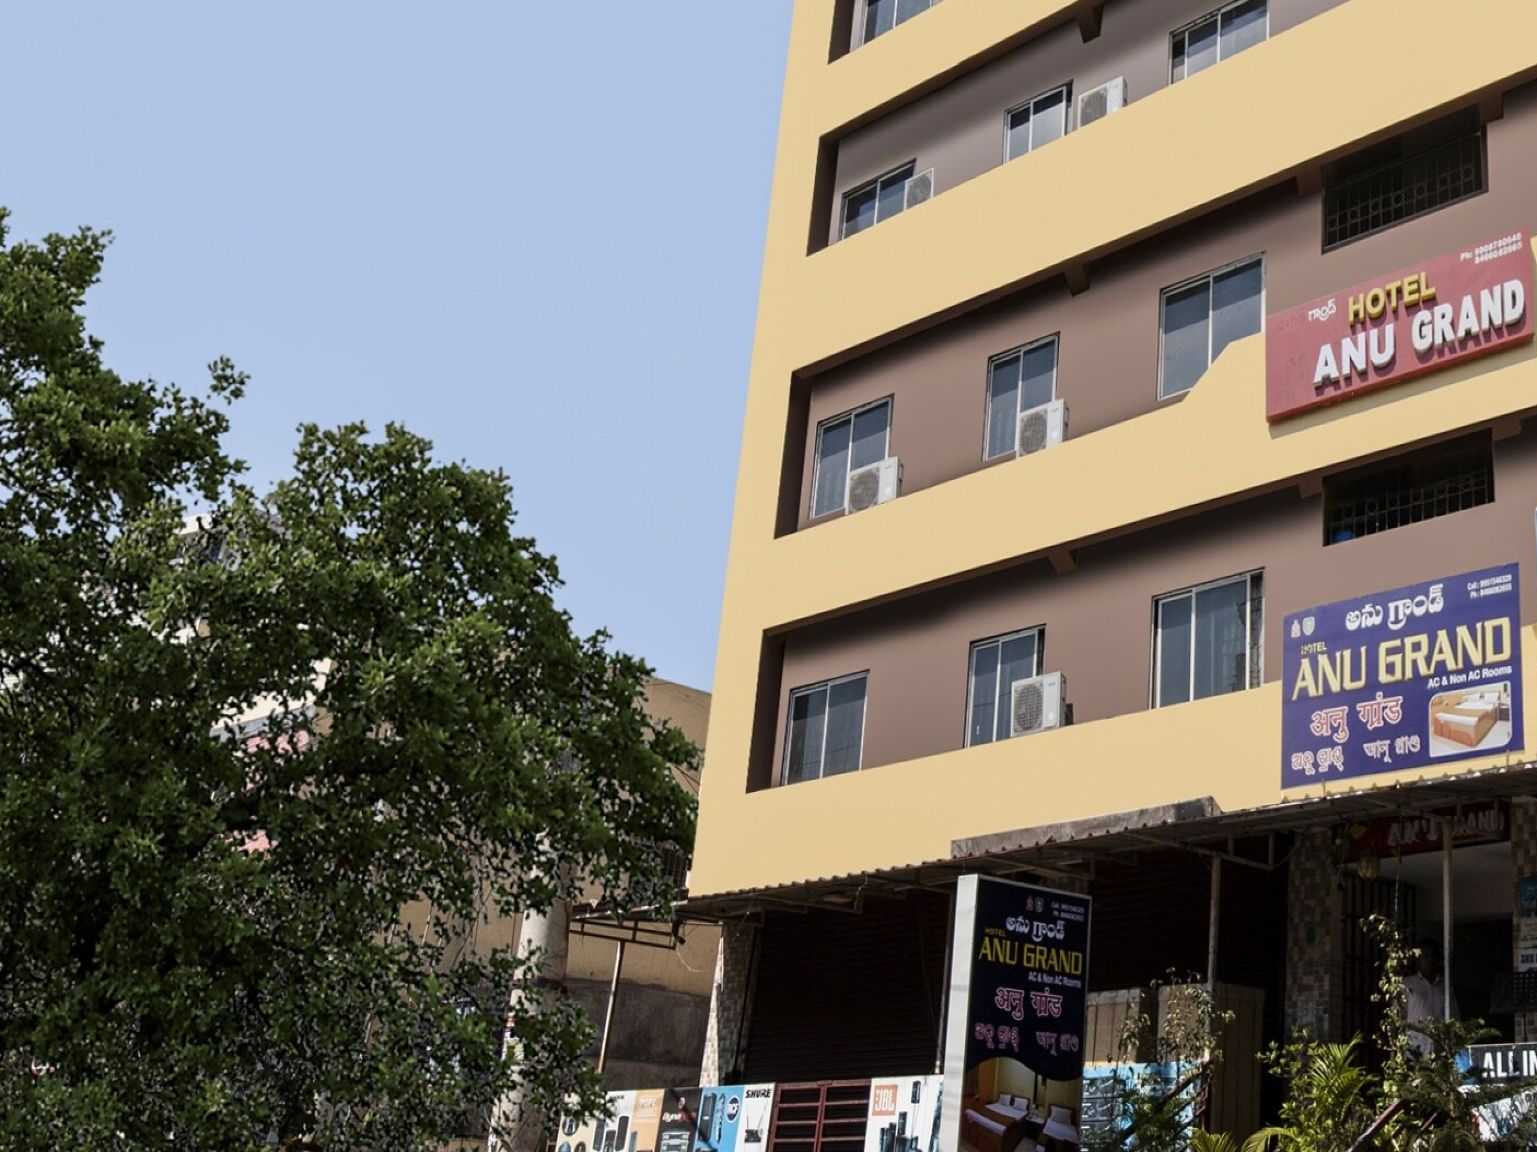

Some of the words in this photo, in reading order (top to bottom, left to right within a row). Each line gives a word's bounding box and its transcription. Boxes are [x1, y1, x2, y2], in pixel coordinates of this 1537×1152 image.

[1348, 271, 1436, 326] HOTEL
[1312, 323, 1396, 386] ANU
[1411, 278, 1526, 353] GRAND
[1292, 646, 1367, 701] ANU
[1378, 616, 1512, 685] GRAND
[1300, 641, 1328, 656] HOTEL
[1427, 676, 1440, 689] AC
[1441, 675, 1448, 686] &
[1449, 673, 1467, 685] Non
[1468, 669, 1481, 681] AC
[1482, 665, 1513, 679] Rooms
[1309, 706, 1350, 744] अनु
[977, 935, 1020, 967] ANU
[1023, 943, 1083, 976] GRAND
[745, 1088, 771, 1099] SHURE
